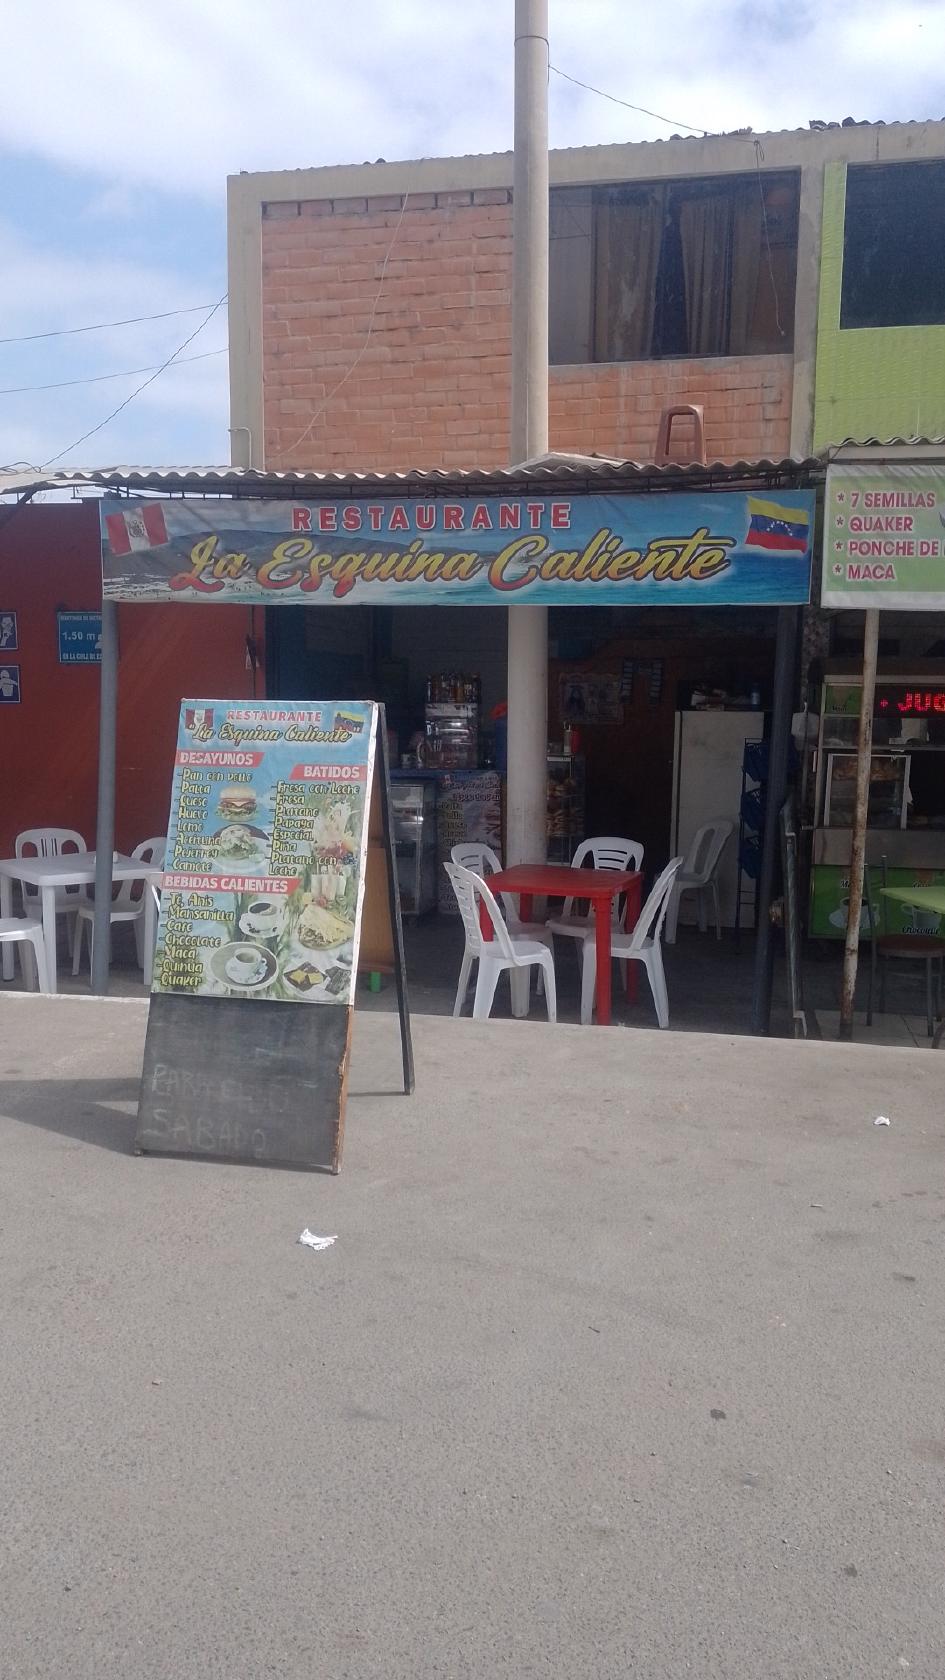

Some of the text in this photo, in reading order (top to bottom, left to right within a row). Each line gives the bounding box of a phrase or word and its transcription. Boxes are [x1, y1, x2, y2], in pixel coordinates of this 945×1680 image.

[851, 493, 936, 508] 7 SEMILLAS
[292, 503, 571, 531] RESTAURANTE
[850, 516, 914, 532] QUAKER
[849, 541, 914, 556] PONCHE
[919, 541, 939, 556] DE
[169, 526, 737, 598] La Esquina Caliente
[848, 564, 896, 580] MACA
[61, 631, 83, 641] 1.50
[86, 633, 96, 641] m
[227, 710, 322, 722] RESTAURANTE
[218, 723, 283, 746] Esquina
[179, 752, 254, 766] DESAYUNOS
[182, 767, 203, 781] Pan
[206, 771, 224, 781] con
[303, 766, 360, 779] BATIDOS
[181, 780, 211, 794] Palta
[277, 780, 360, 795] Fresa con Leche
[179, 794, 208, 808] Queso
[276, 793, 305, 806] Fresa
[178, 806, 208, 820] Huevo
[274, 816, 315, 829] Papaya
[272, 828, 314, 841] Especial
[174, 844, 219, 858] Pejerrey
[272, 840, 297, 852] Piña
[172, 858, 212, 872] Camote
[318, 856, 337, 865] con
[268, 862, 297, 876] Leche
[164, 875, 288, 893] BEBIDAS CALIENTES
[188, 892, 214, 907] Anis
[168, 906, 235, 921] Mansanilla
[164, 933, 221, 948] Chocolate
[163, 946, 197, 960] Maca
[162, 959, 203, 974] Quinua
[161, 972, 202, 987] Quaker
